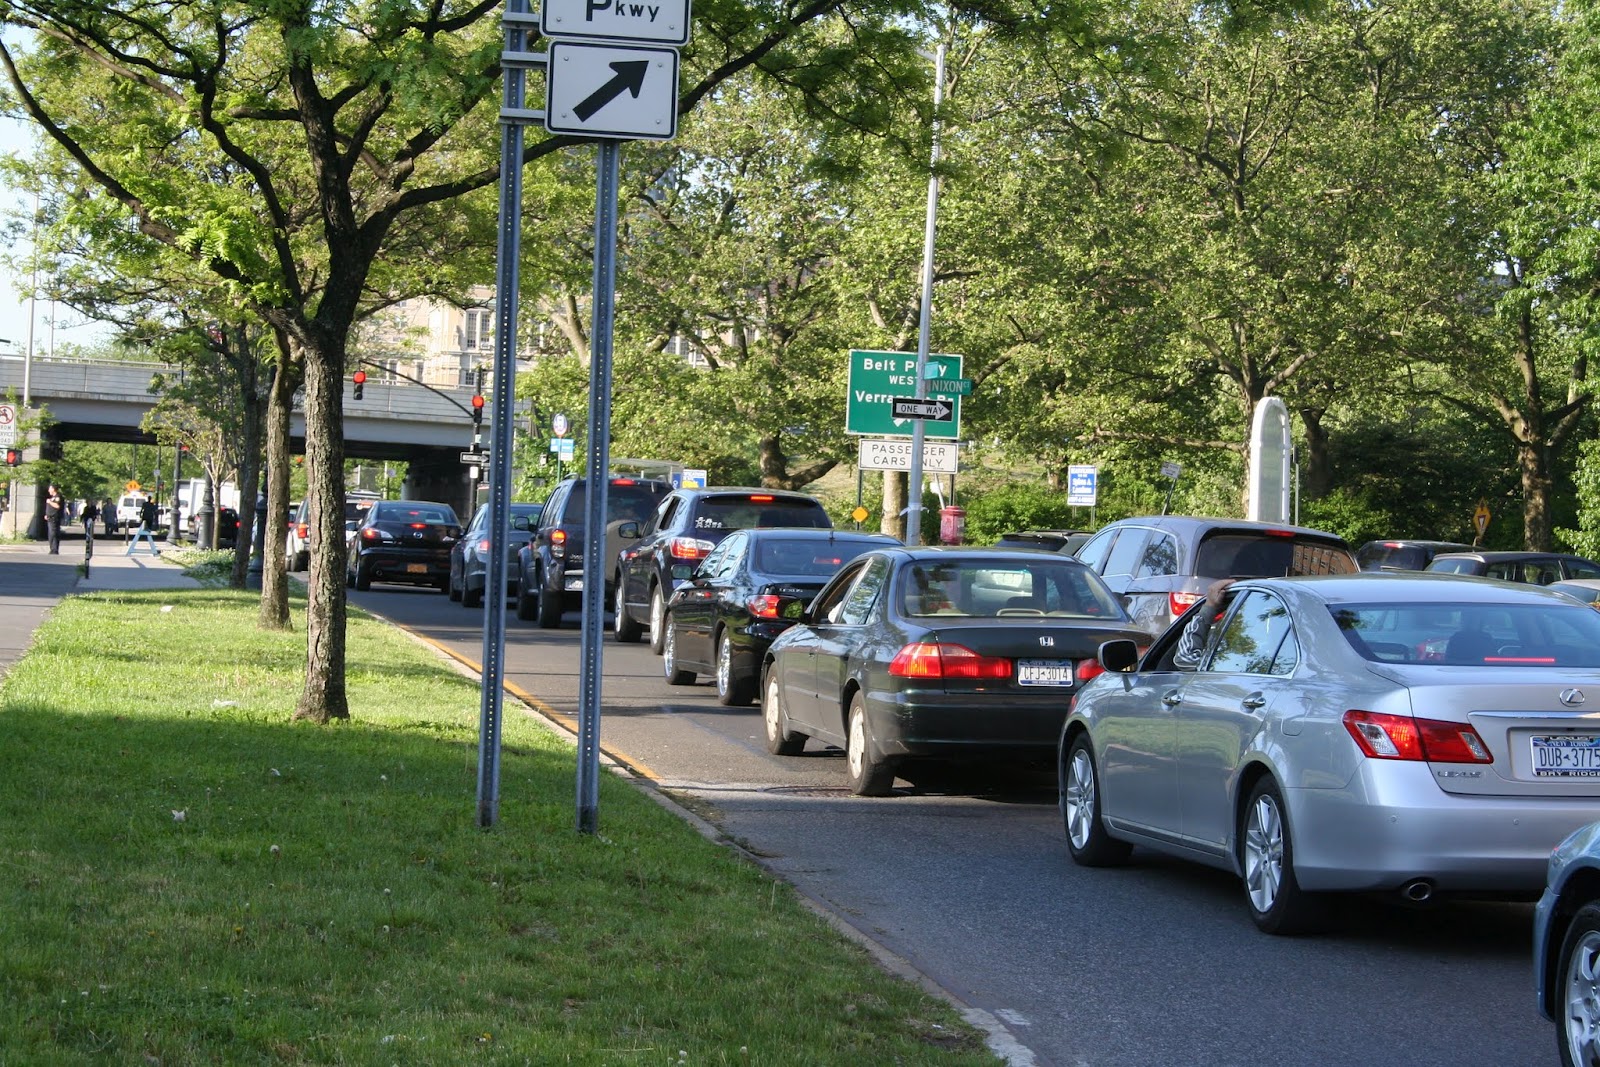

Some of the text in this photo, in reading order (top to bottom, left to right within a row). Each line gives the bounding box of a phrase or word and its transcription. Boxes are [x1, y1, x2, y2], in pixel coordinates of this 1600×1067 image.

[586, 0, 660, 22] Pkwy
[863, 358, 895, 371] Belt
[889, 375, 919, 386] WES
[931, 380, 963, 393] NIXON
[900, 404, 944, 415] ONE WAY
[872, 444, 946, 456] PASSEGER
[873, 455, 906, 466] CARS
